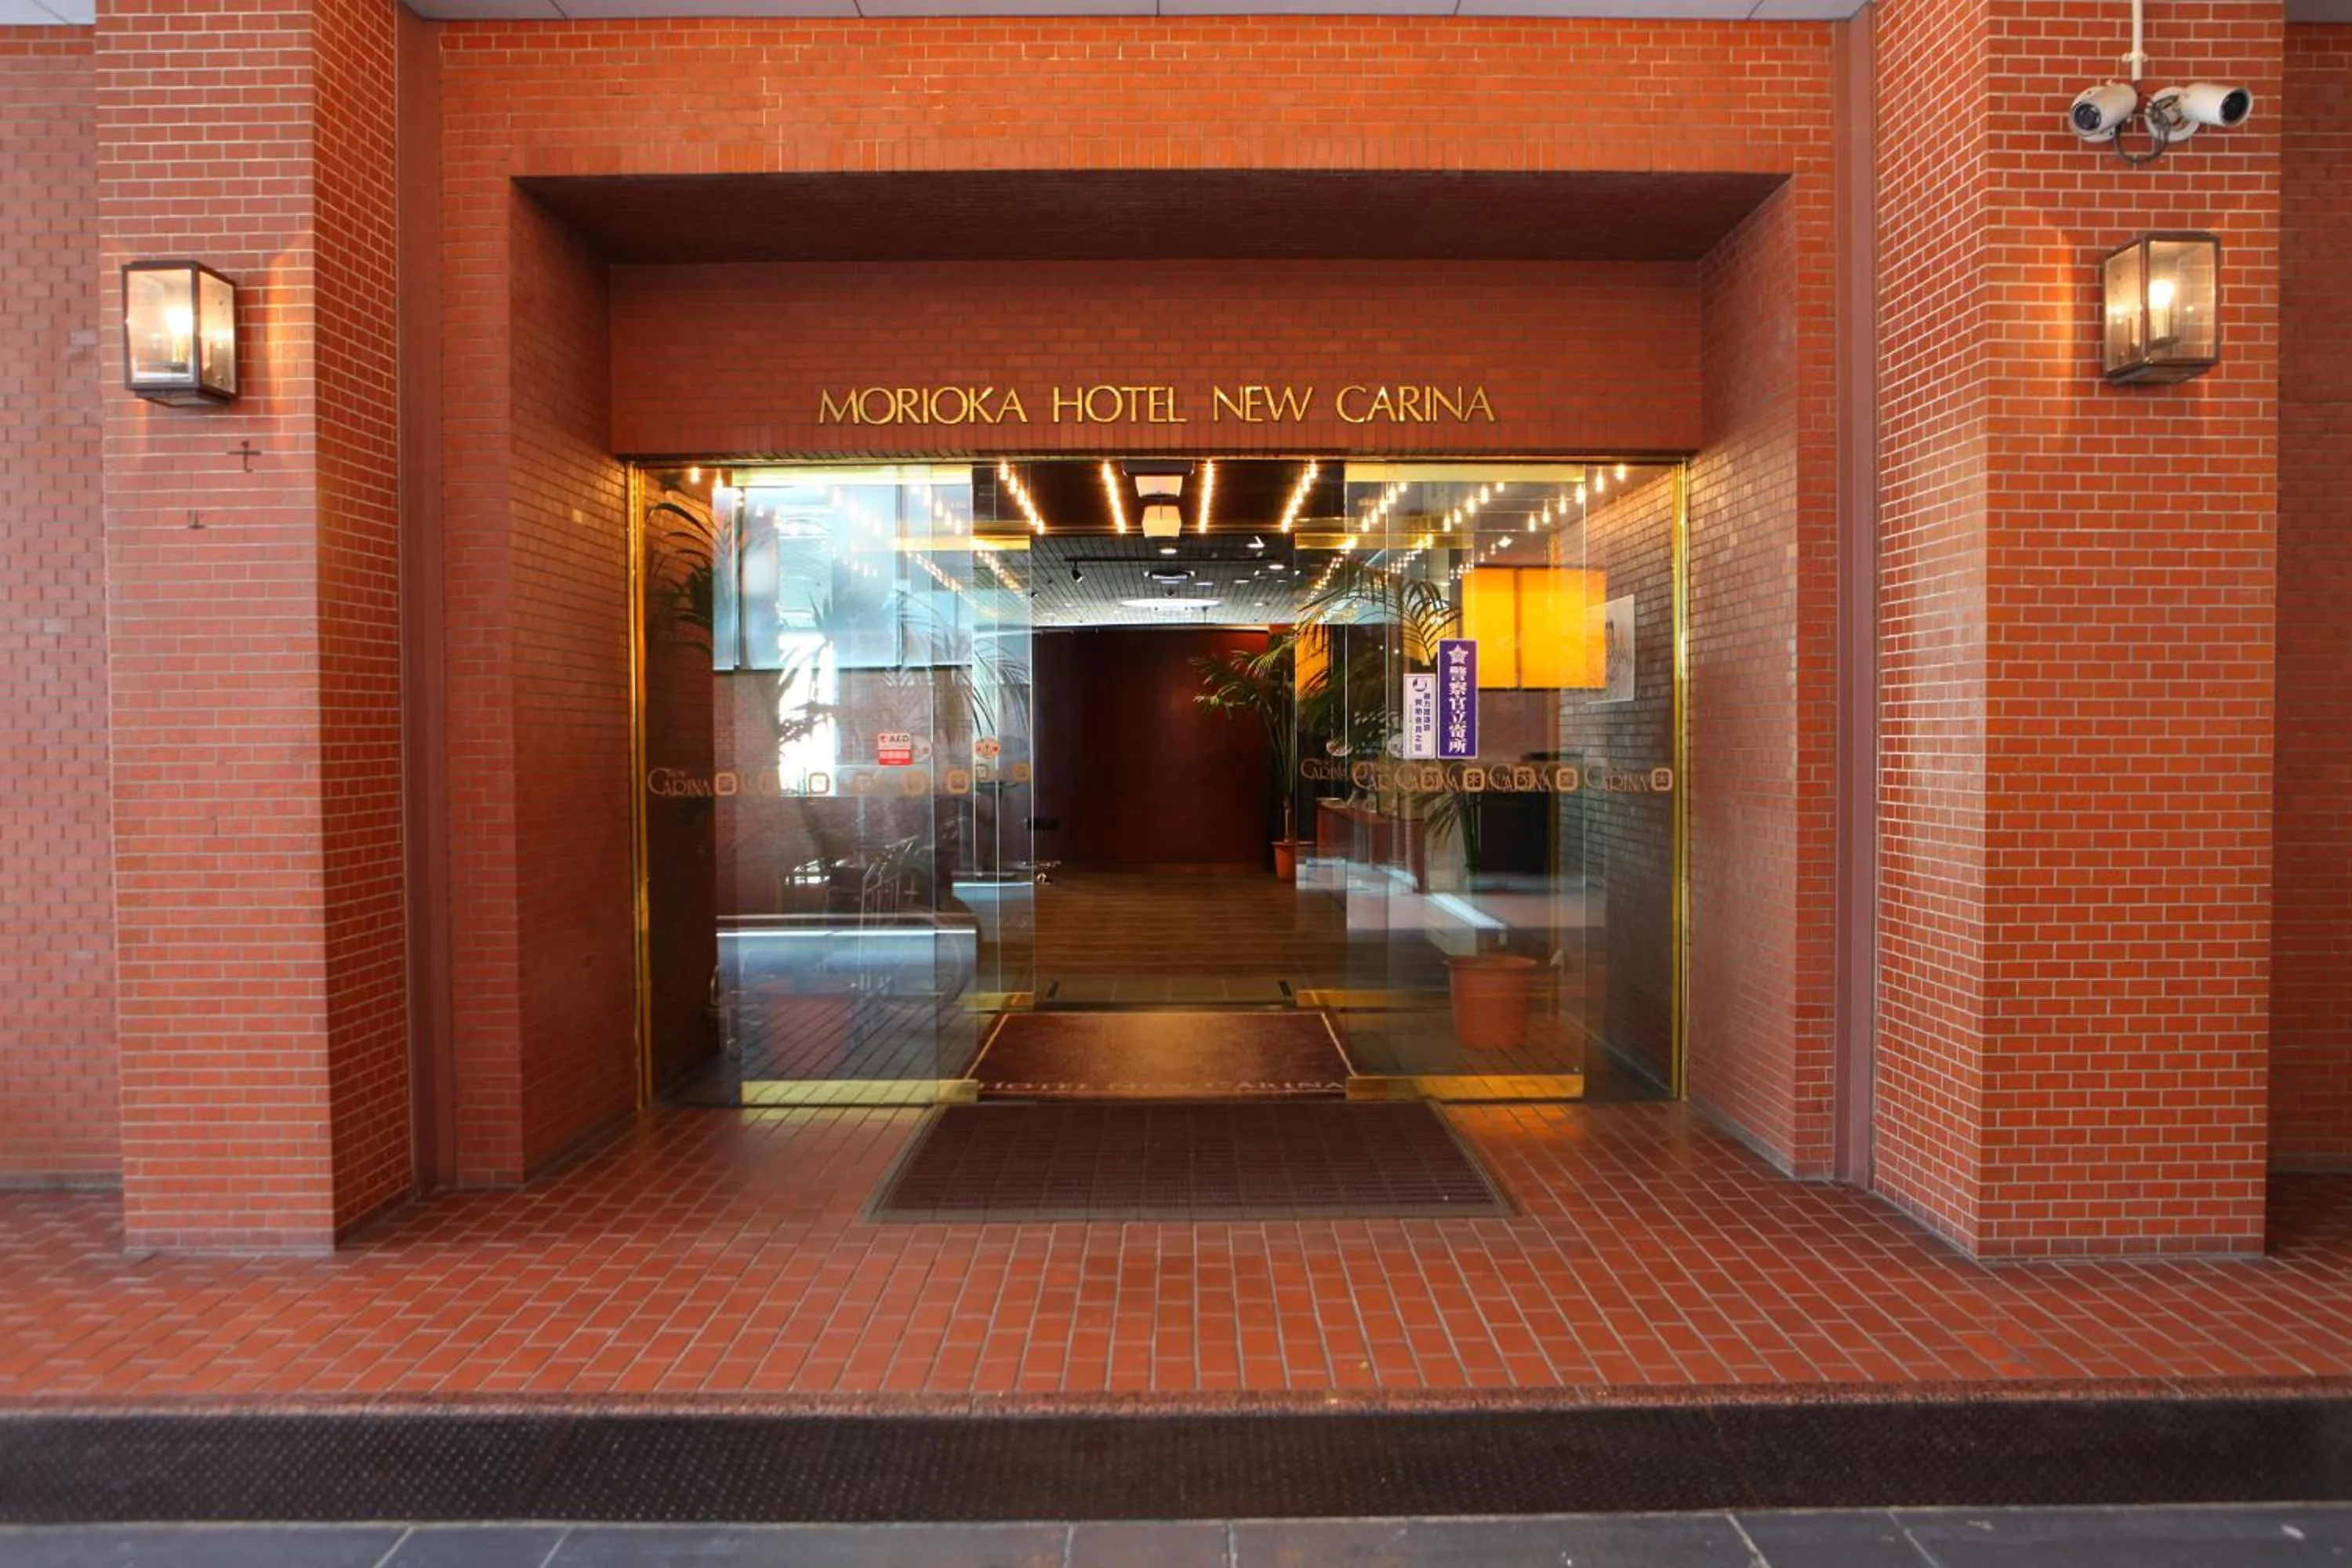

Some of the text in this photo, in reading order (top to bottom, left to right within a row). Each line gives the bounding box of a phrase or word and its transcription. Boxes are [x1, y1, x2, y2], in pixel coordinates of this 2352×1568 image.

[818, 384, 1495, 425] MORIOKA HOTEL NEW CARINA
